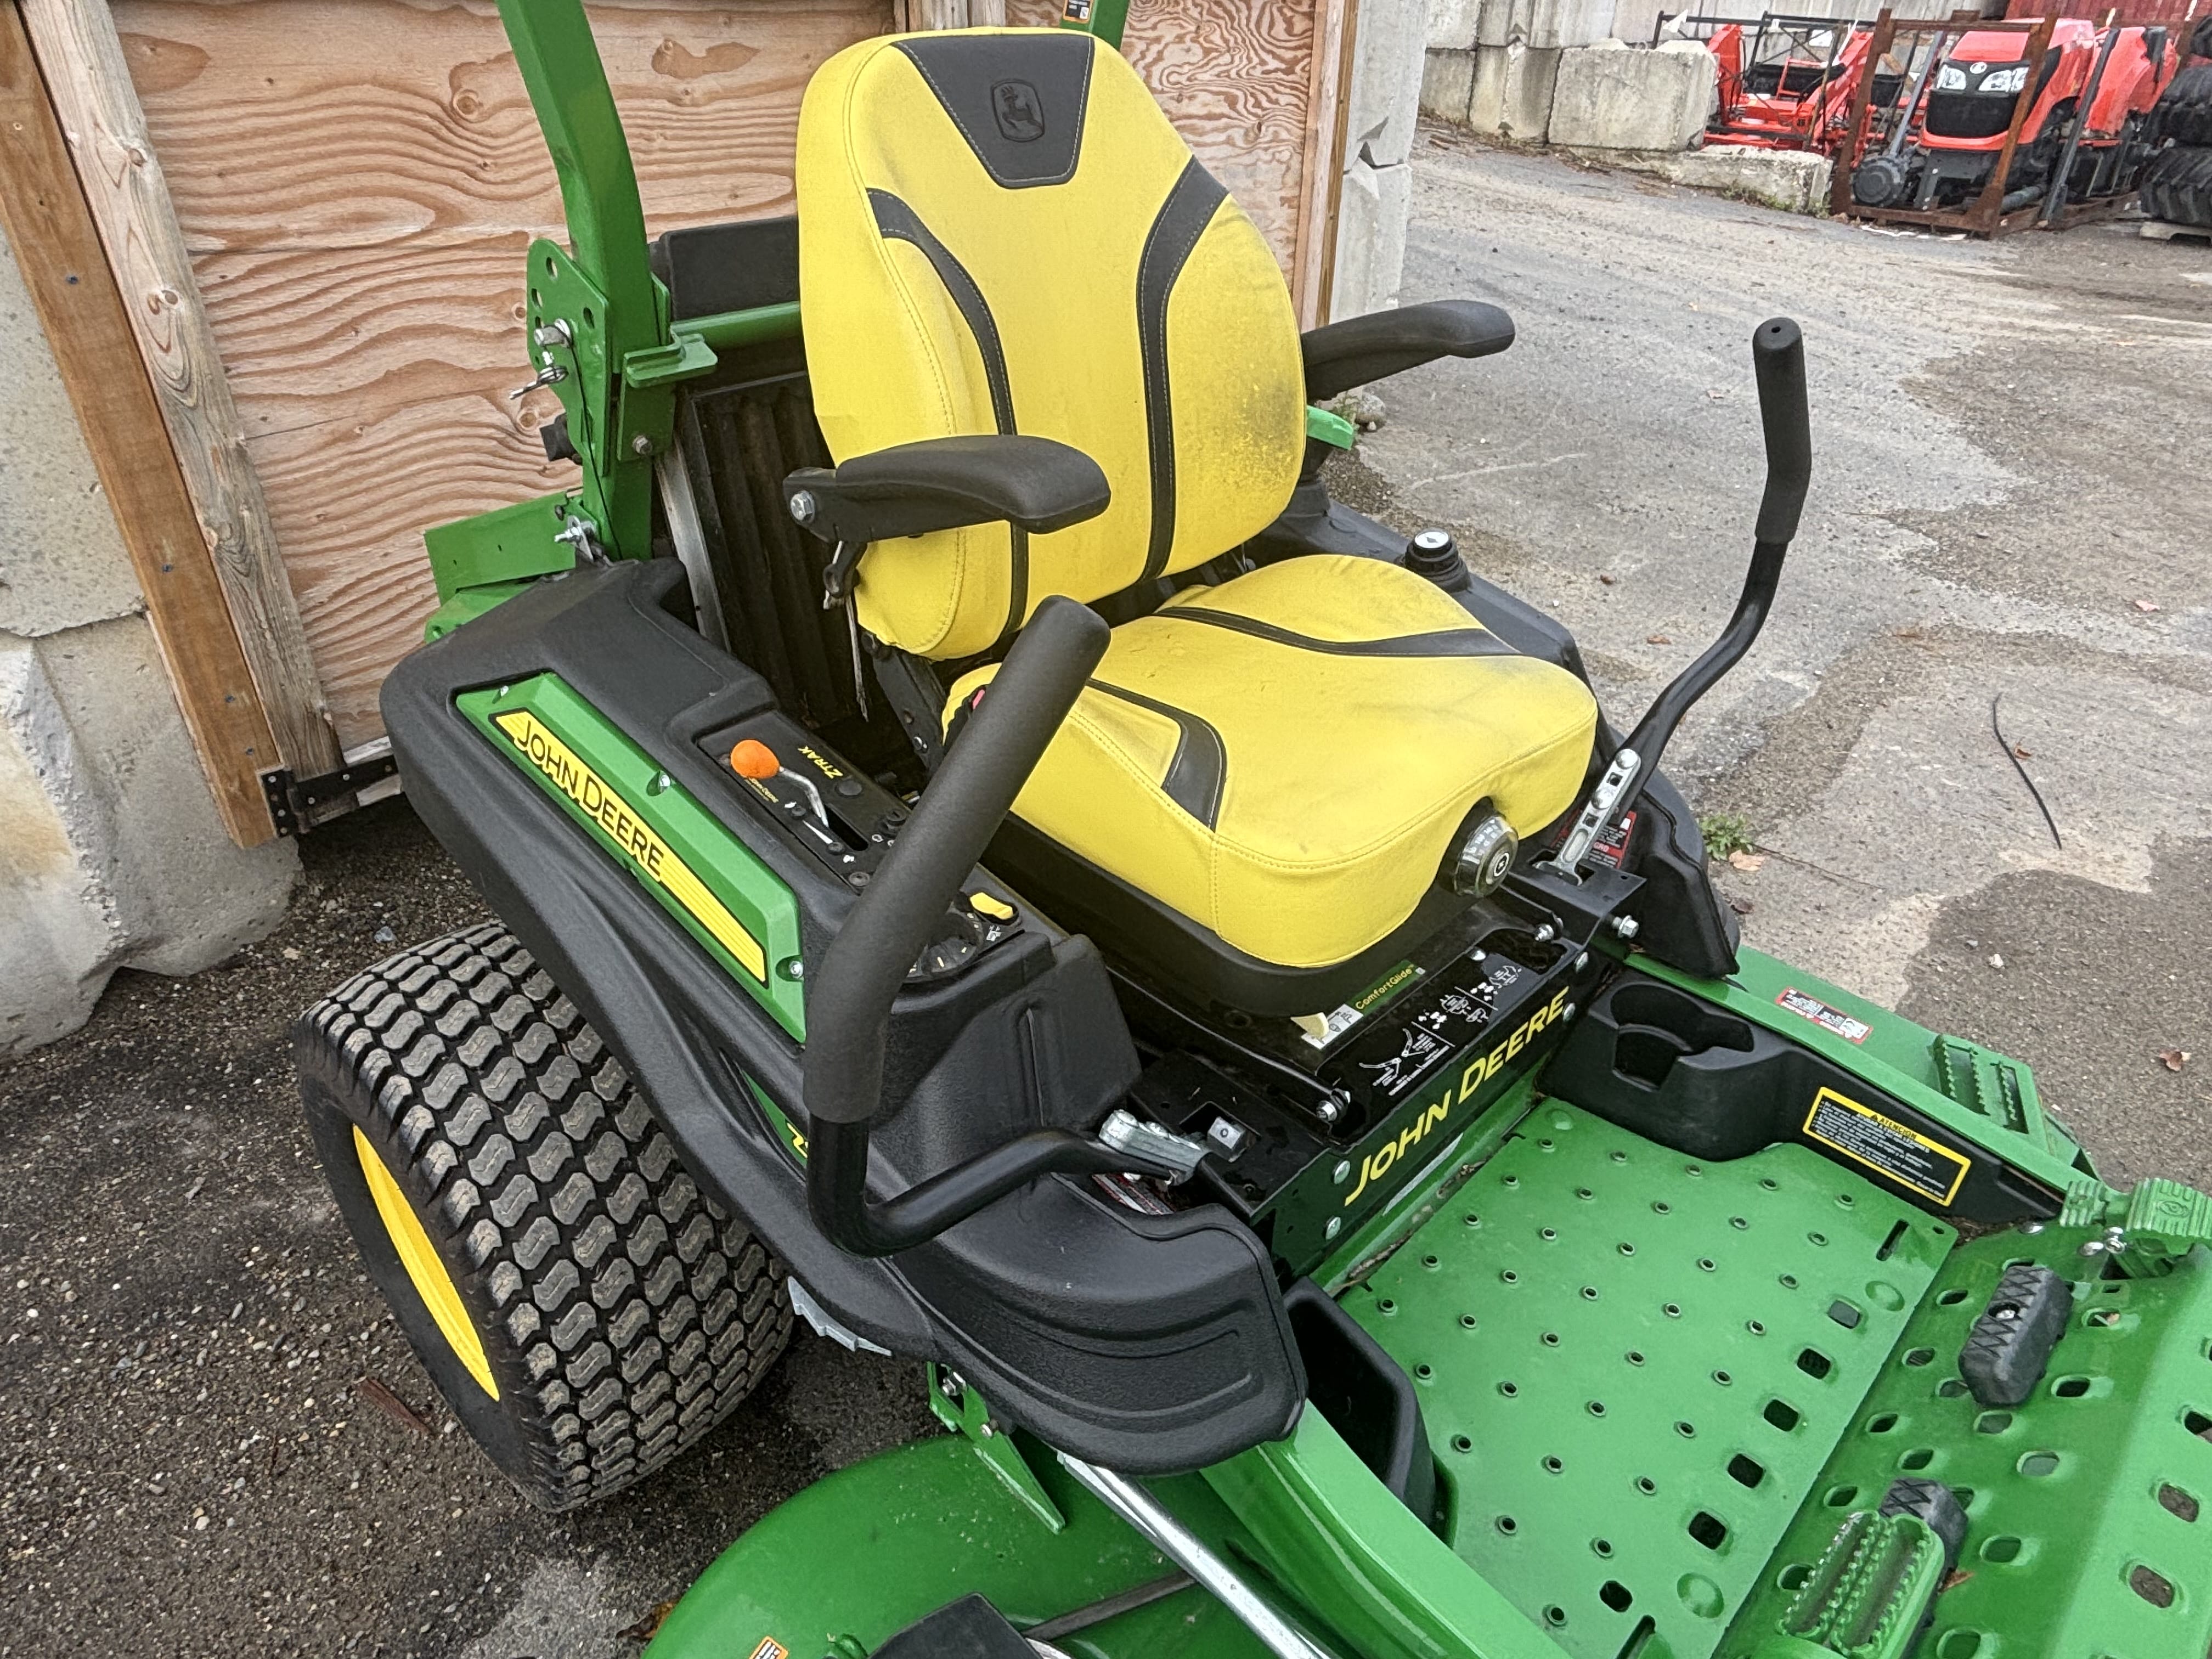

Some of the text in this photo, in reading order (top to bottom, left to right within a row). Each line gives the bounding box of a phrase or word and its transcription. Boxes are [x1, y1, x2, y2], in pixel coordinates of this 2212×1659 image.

[517, 720, 664, 877] JOHN DEERE
[798, 746, 843, 779] ZTRAK
[1344, 1088, 1452, 1207] JOHN
[1458, 985, 1570, 1105] DEERE
